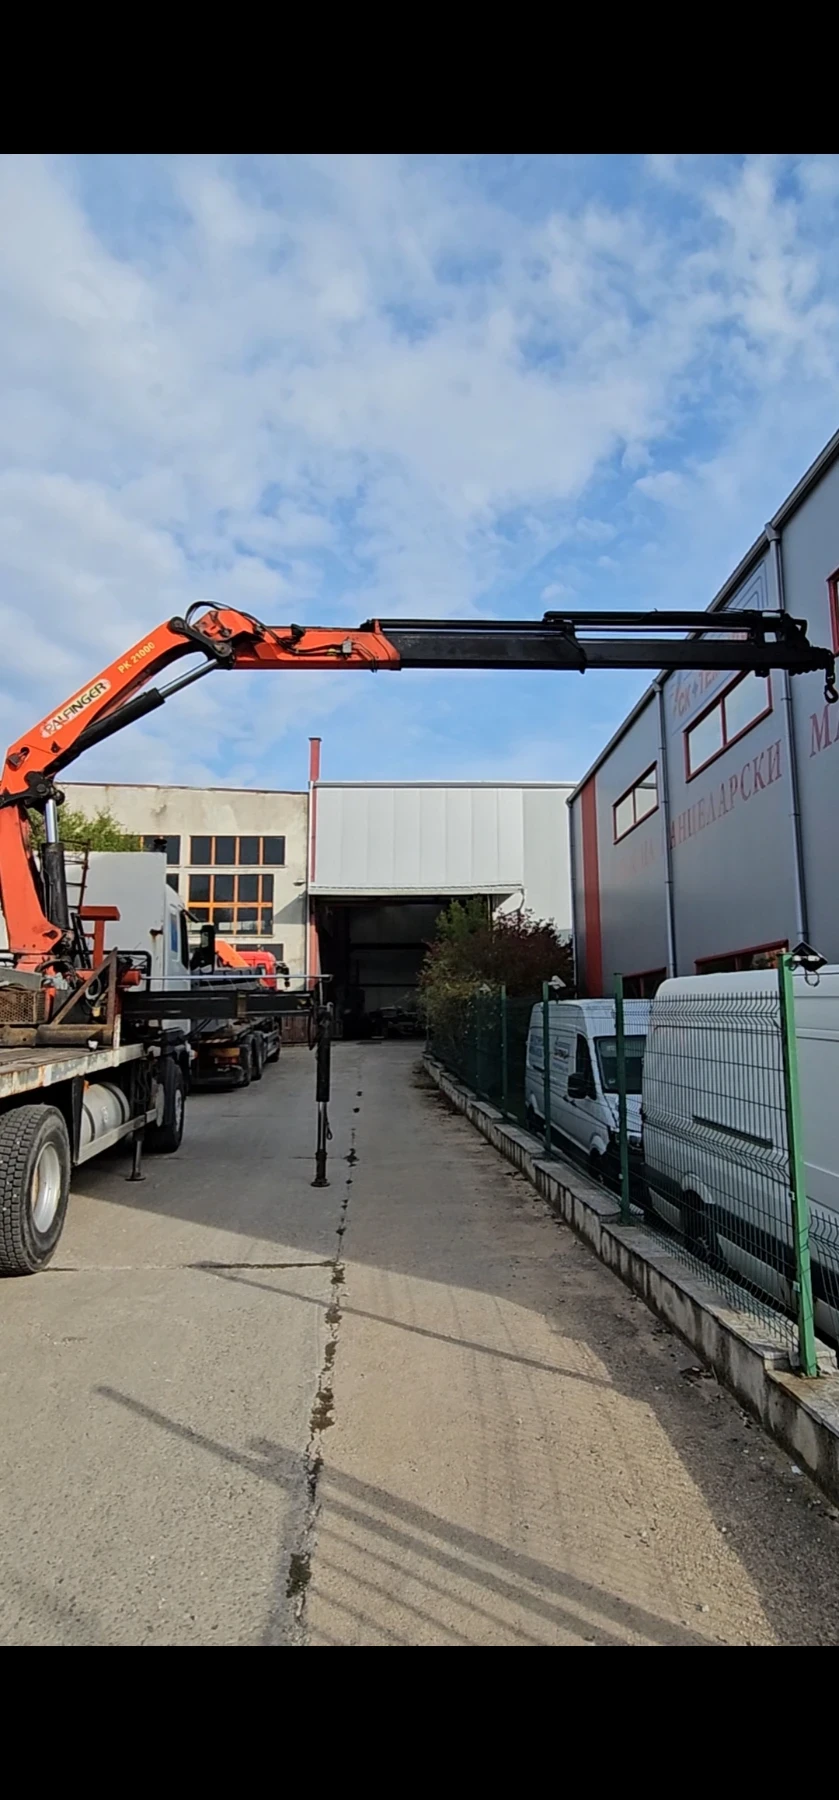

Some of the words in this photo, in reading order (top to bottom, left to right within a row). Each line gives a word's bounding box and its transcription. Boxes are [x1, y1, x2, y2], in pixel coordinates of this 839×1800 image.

[118, 659, 132, 673] PK
[131, 642, 155, 663] 21000
[43, 682, 107, 735] PALFINGER
[663, 740, 782, 853] АНЦЕЛАРСКИ
[809, 702, 839, 758] М
